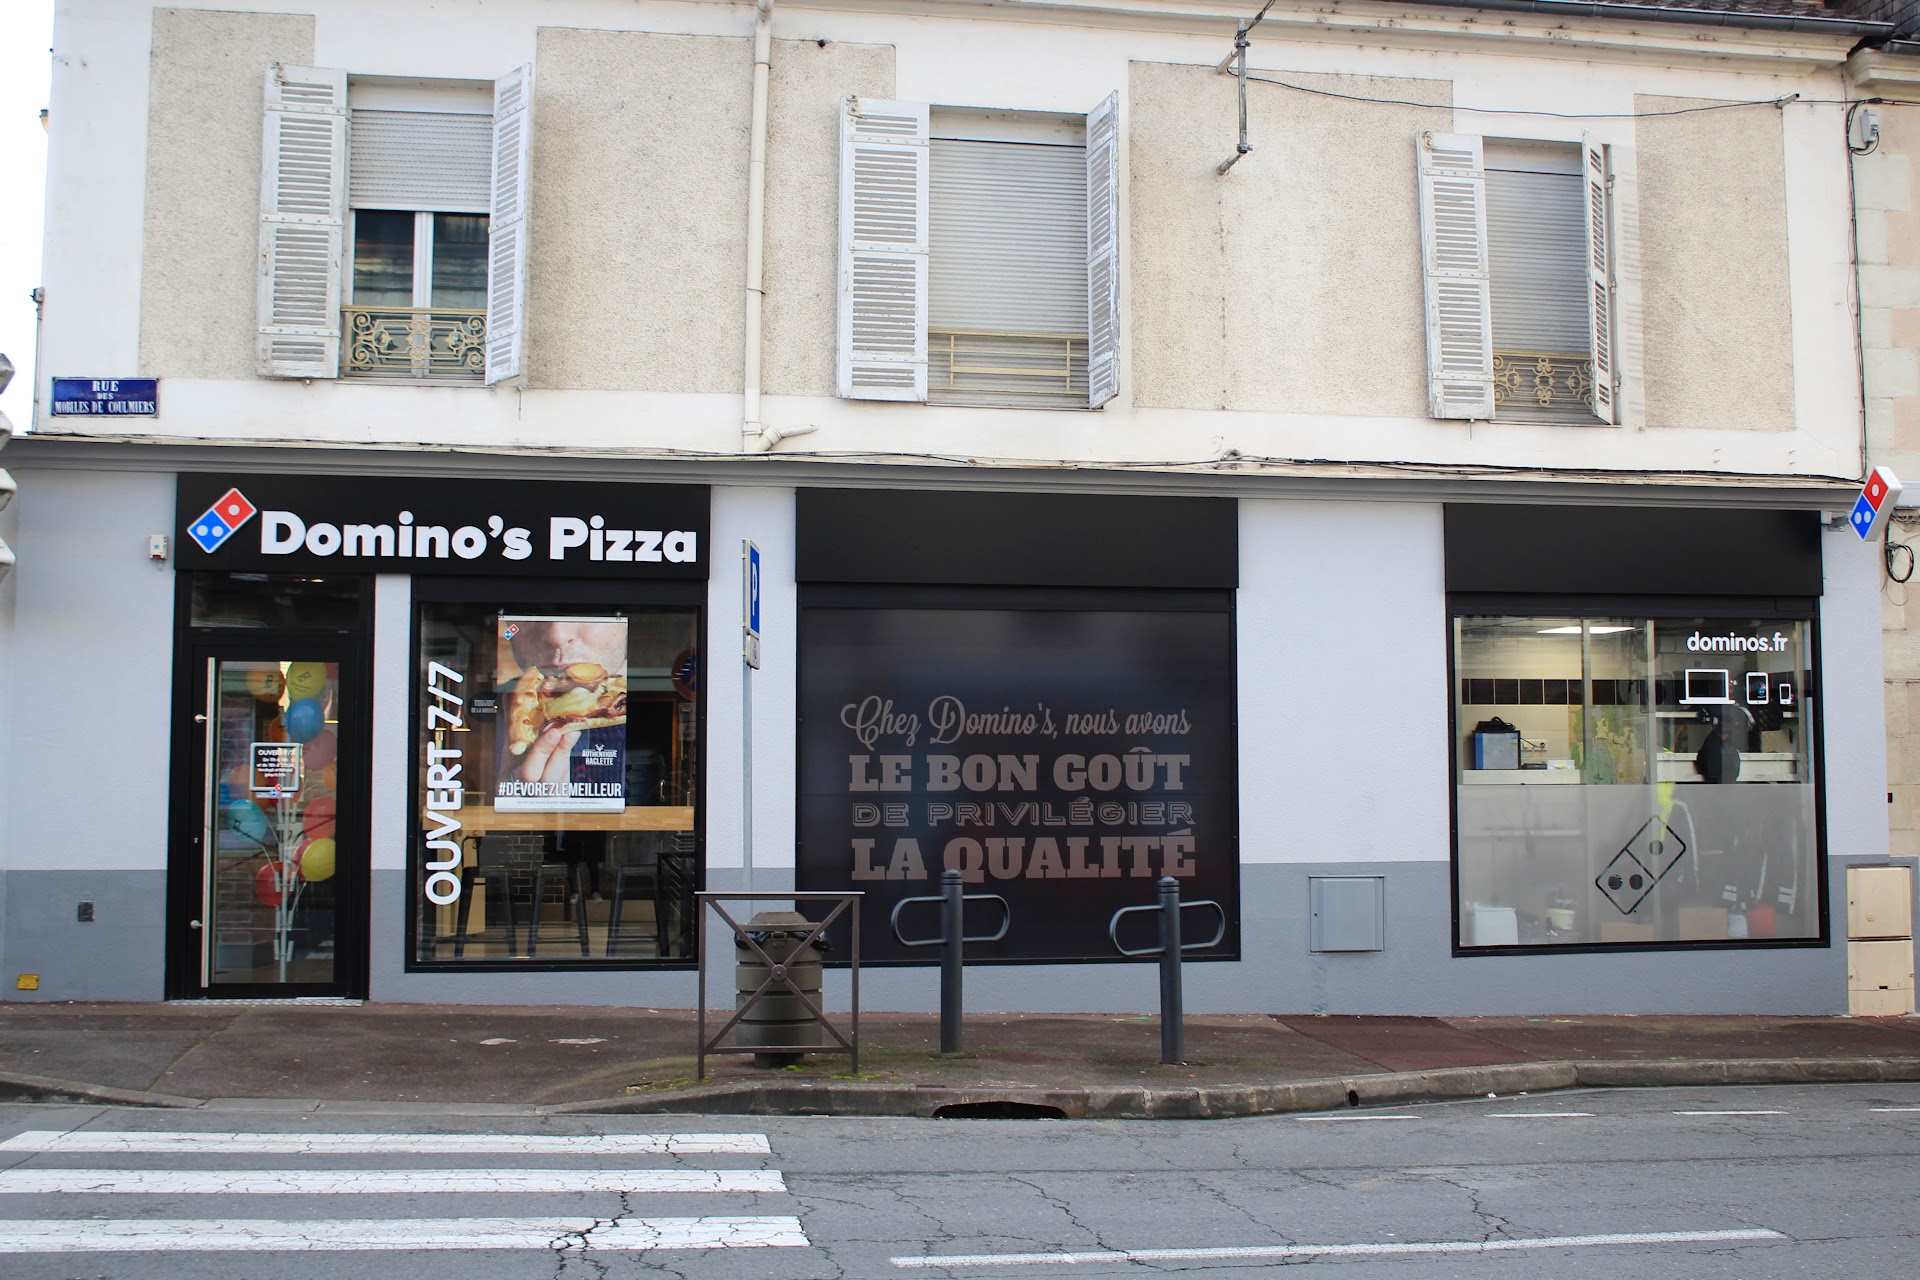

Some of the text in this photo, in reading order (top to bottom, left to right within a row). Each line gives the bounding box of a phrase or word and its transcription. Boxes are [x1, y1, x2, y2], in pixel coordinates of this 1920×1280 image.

[92, 380, 119, 392] RUE
[97, 392, 114, 400] DES
[54, 401, 155, 414] MOBILES DE COULMIERS
[261, 510, 698, 563] Domino’s Pizza
[752, 561, 758, 617] P
[1687, 631, 1789, 652] dominos.fr
[840, 695, 1192, 751] Chez Domino's, nous avons
[581, 749, 618, 758] AUTHENTIQUE
[585, 758, 614, 766] RACLETTE
[849, 746, 1191, 792] LE BON GOÛT
[425, 661, 464, 905] OUVERT 7/7
[498, 780, 622, 797] #DÉVOREZLEMEILLEUR
[852, 797, 1196, 827] DE PRIVILÉGIER
[851, 828, 1196, 883] LA QUALITÉ
